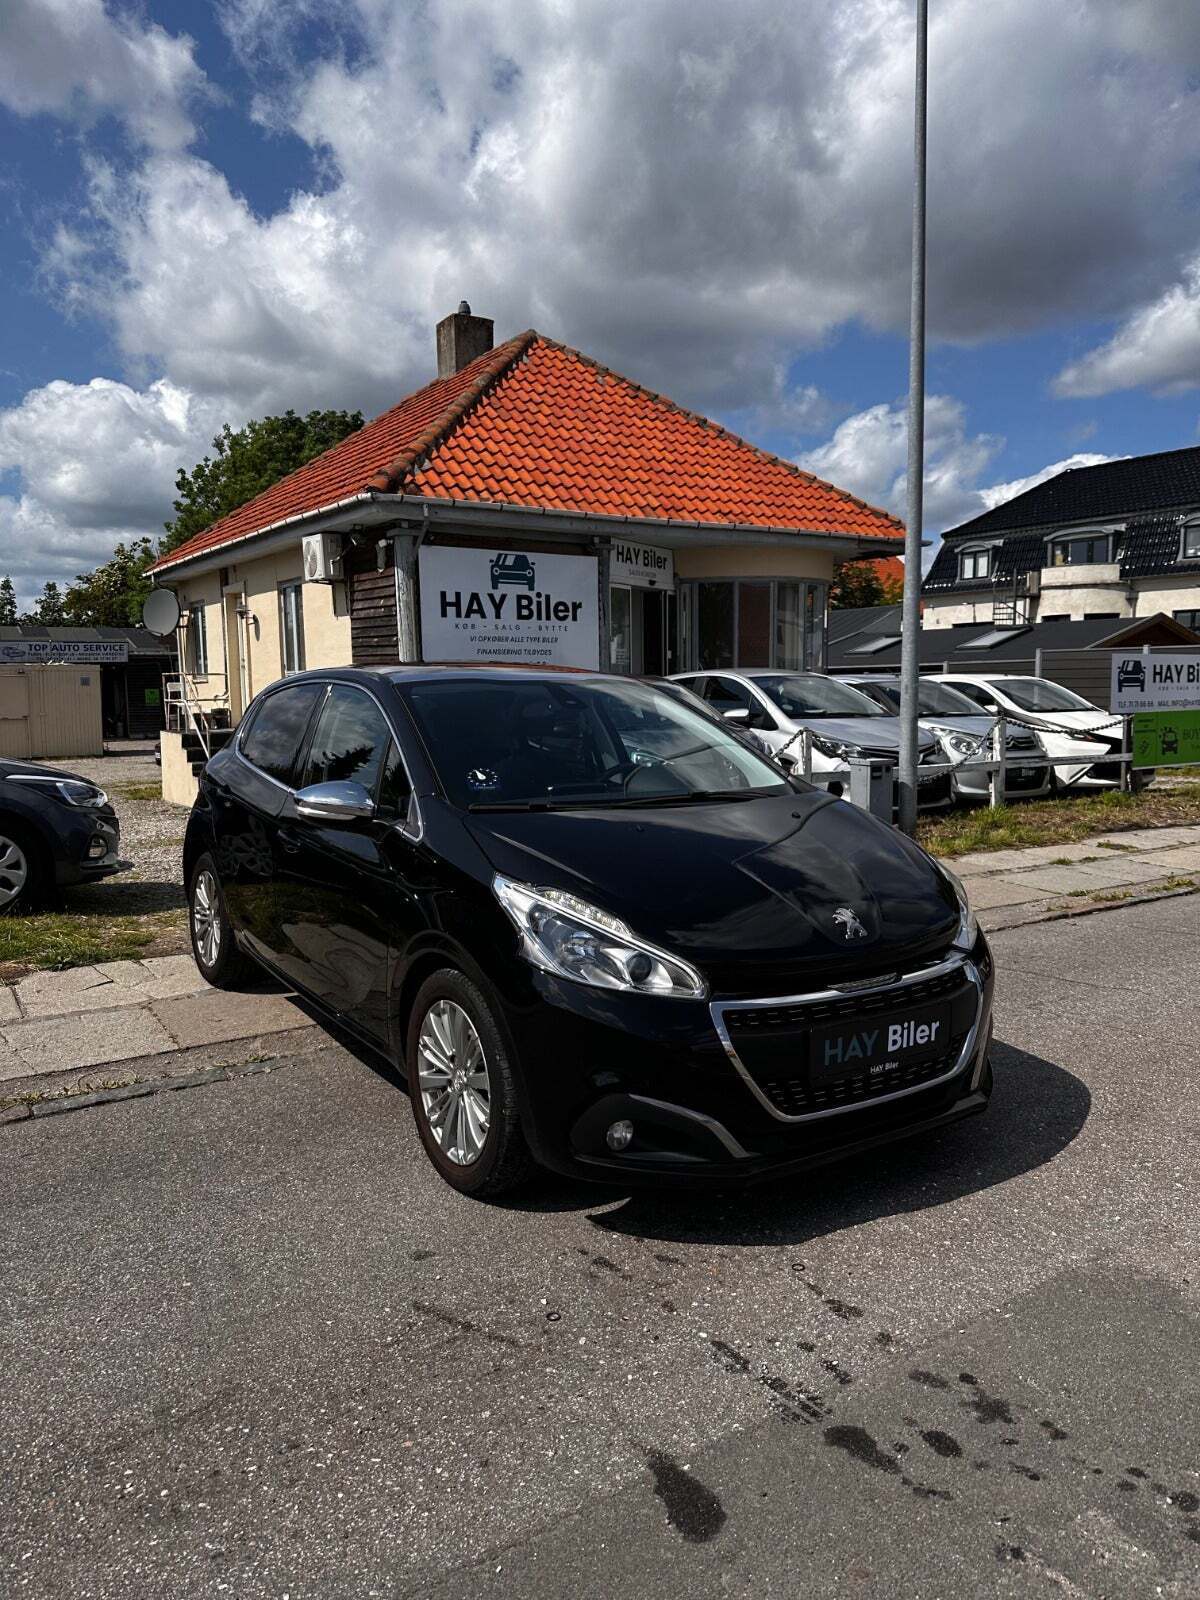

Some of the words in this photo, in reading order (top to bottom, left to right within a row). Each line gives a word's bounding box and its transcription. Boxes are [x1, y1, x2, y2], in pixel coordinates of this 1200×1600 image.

[616, 544, 641, 566] HAY
[642, 549, 667, 570] Biler
[440, 591, 508, 620] HAY
[516, 591, 583, 622] Biler
[28, 643, 48, 651] TOP
[1152, 664, 1184, 683] HAY
[824, 1029, 879, 1066] HAY
[887, 1020, 940, 1053] Biler
[870, 1064, 884, 1074] HAY
[884, 1061, 899, 1071] Biler
